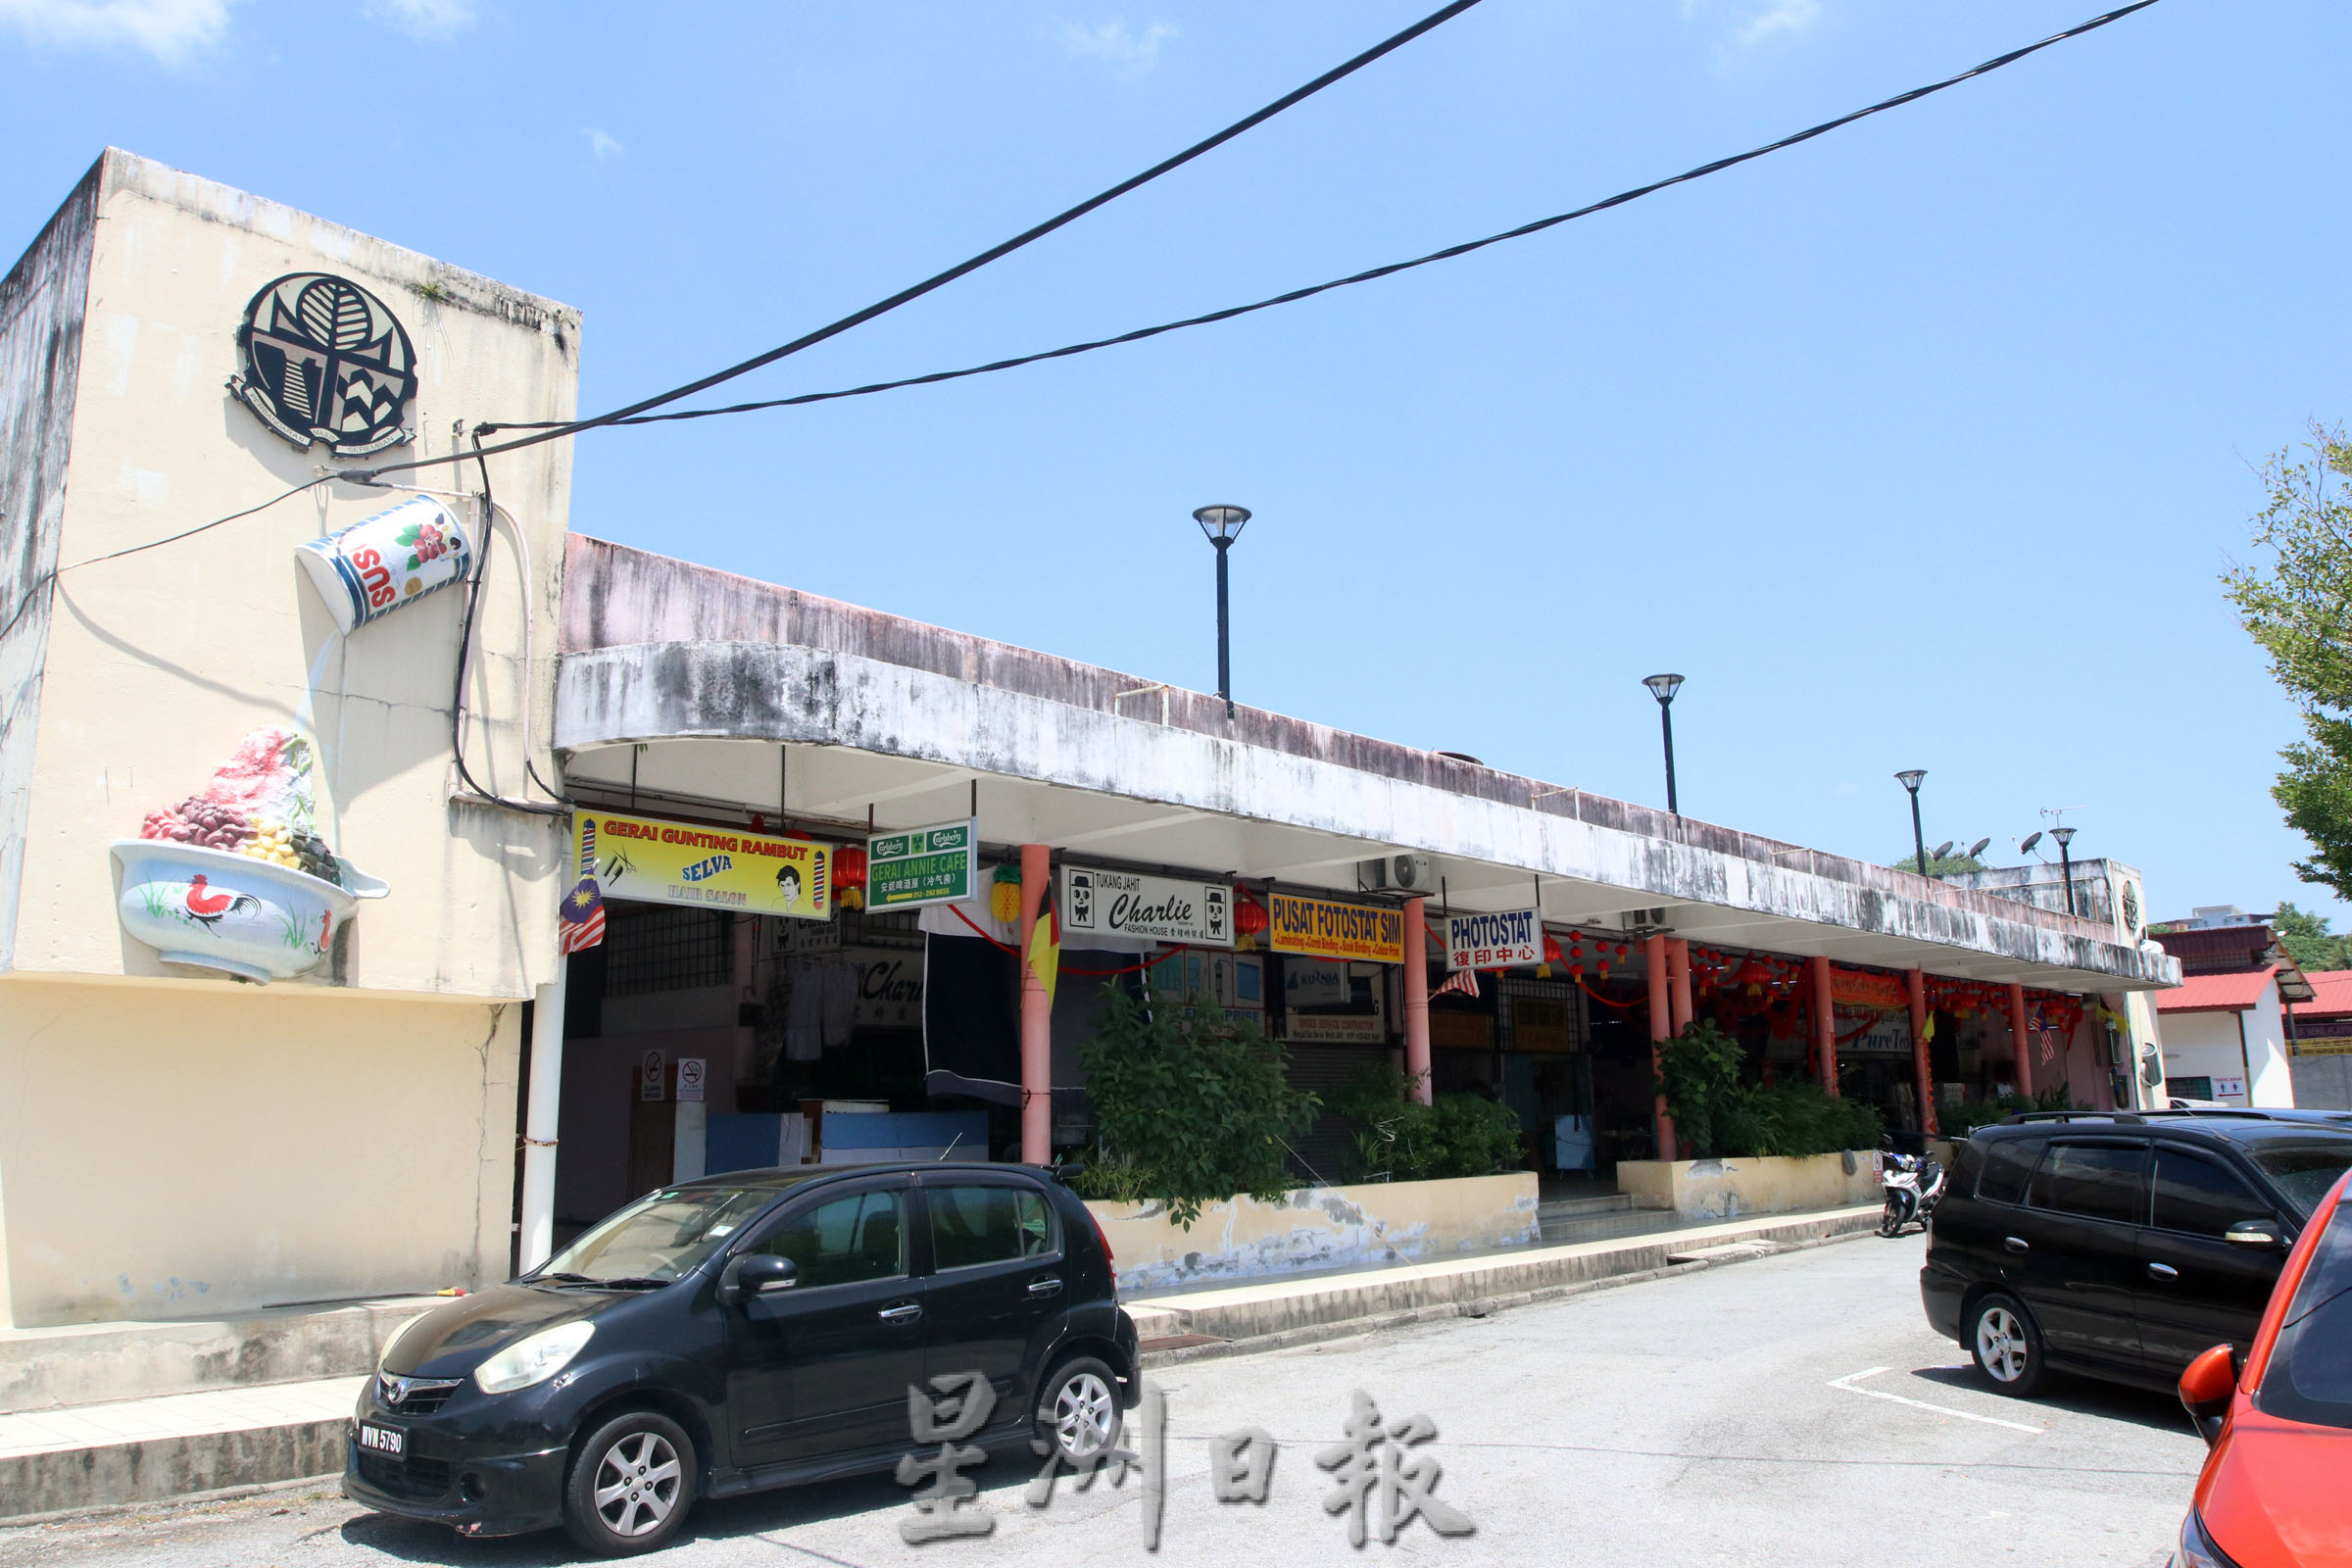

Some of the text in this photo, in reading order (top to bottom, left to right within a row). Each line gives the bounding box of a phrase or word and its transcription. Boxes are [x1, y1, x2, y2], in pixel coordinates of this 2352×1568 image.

[249, 393, 306, 443] PERBANDARAN
[347, 436, 394, 454] SEREMBAN
[604, 820, 808, 860] GERAI GUNTING RAMBUT
[876, 830, 961, 857] Carlsberg Carlsberg
[682, 855, 733, 882] SELVA
[871, 854, 966, 882] GERAI ANNIE CAFE
[667, 884, 747, 906] HAIR SALON
[1096, 873, 1141, 892] TUKANG JAHIT
[1108, 893, 1193, 929] Charlie
[1273, 898, 1401, 944] PUSAT FOTOSTAT SIM
[1124, 923, 1149, 935] FASHION
[1150, 926, 1168, 937] HOUSE
[1451, 911, 1533, 950] PHOTOSTAT
[1276, 933, 1304, 950] Laminating
[1307, 936, 1321, 948] Comb
[1321, 938, 1339, 954] Binding
[1343, 940, 1355, 952] Book
[1355, 941, 1372, 956] Binding
[1375, 944, 1389, 956] Colour
[1453, 945, 1535, 966] 復印中心
[379, 1429, 402, 1453] 5790
